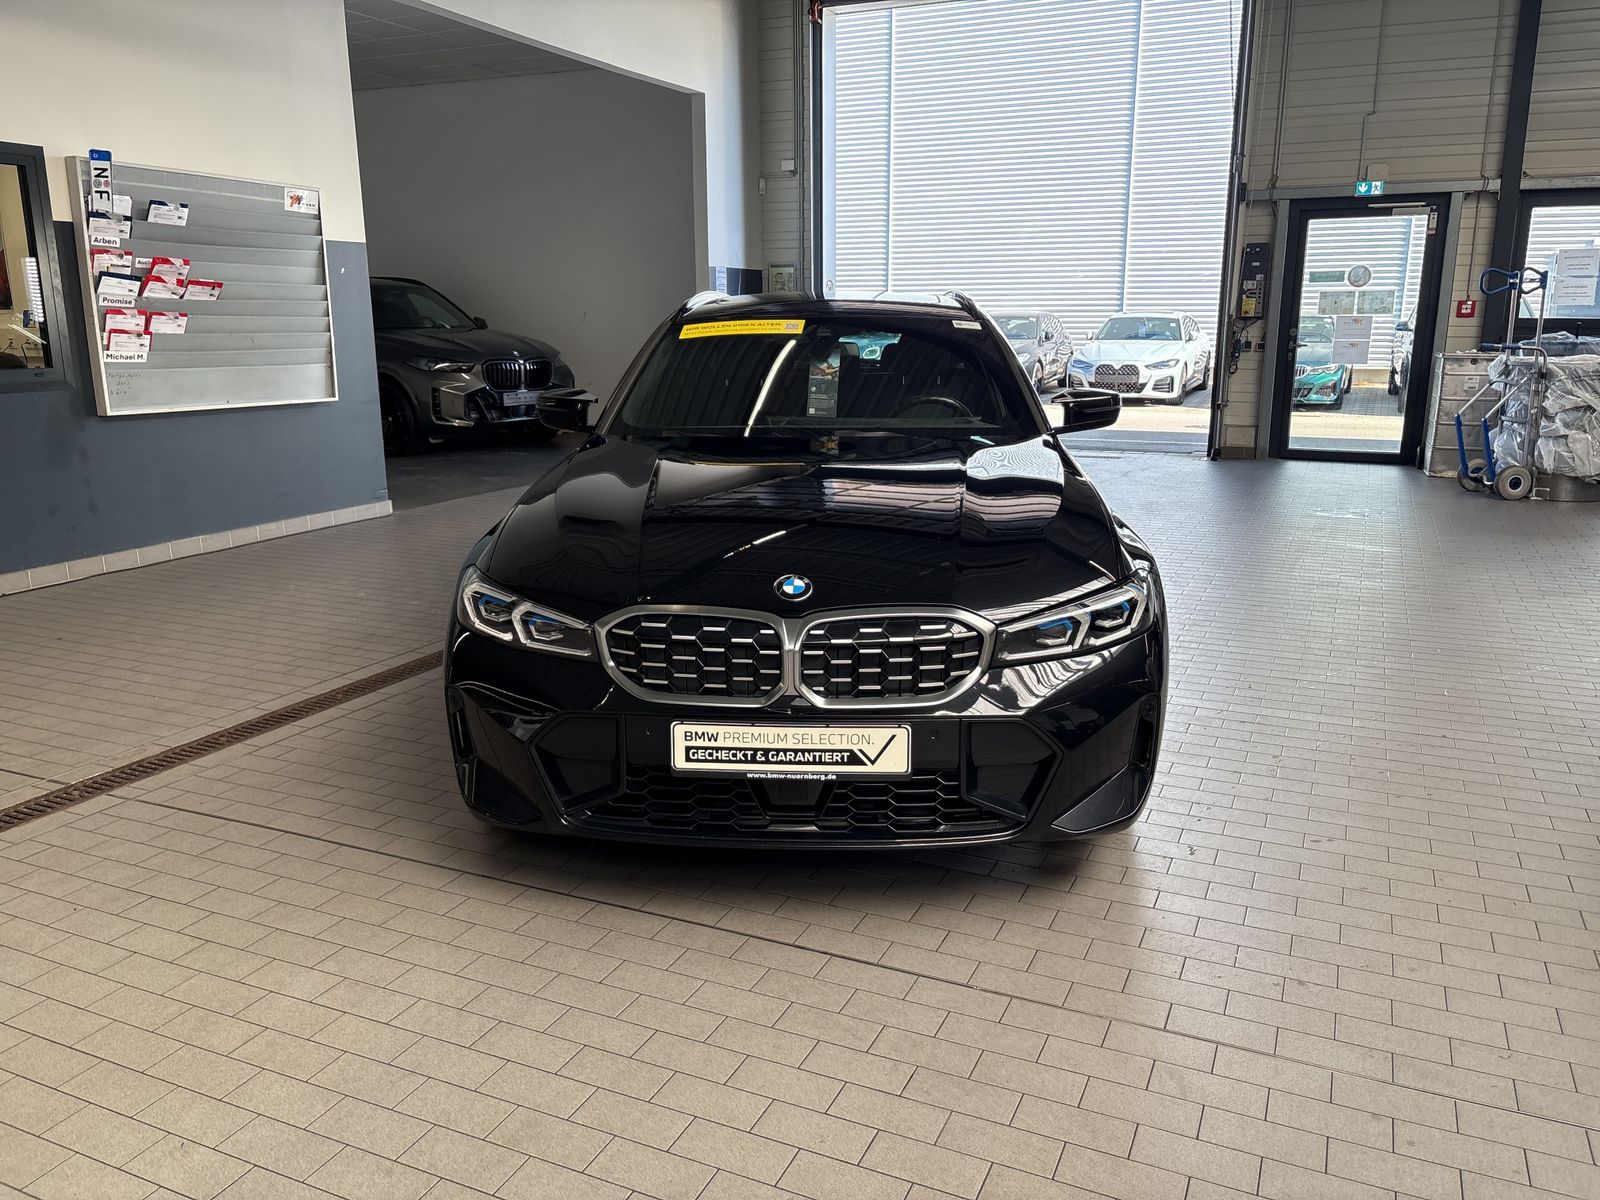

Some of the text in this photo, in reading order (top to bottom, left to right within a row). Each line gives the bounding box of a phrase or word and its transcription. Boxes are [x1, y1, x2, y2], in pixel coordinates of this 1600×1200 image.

[93, 167, 109, 179] N
[94, 190, 110, 201] F
[93, 236, 117, 246] Arben
[102, 296, 133, 306] Promise
[106, 353, 136, 361] Michael
[684, 730, 875, 746] BMW PREMIUM SELECTION.
[689, 748, 850, 763] GECHECKT & GARANTIERT
[747, 771, 837, 781] www.bmw-nuernberg.de
